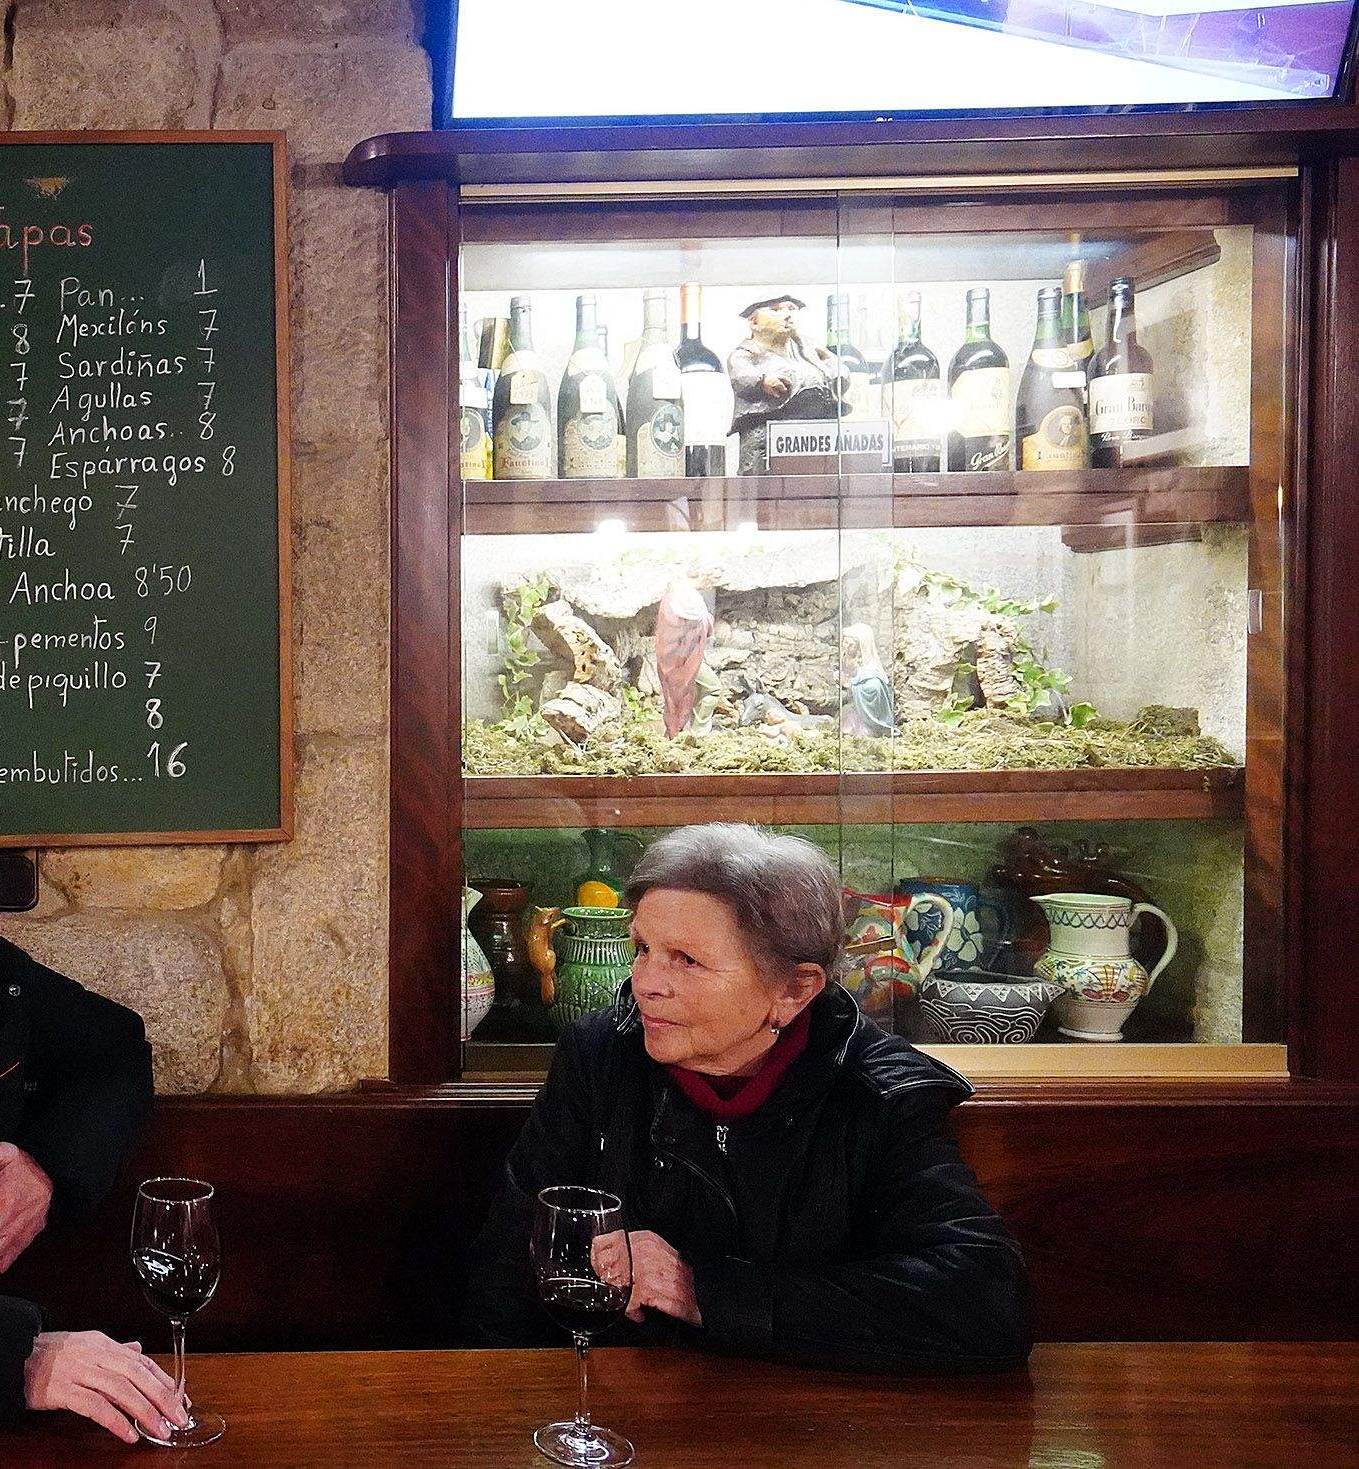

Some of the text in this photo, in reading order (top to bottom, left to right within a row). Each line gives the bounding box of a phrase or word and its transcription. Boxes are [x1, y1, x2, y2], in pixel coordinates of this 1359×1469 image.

[194, 258, 217, 295] 1
[14, 280, 35, 314] 7
[12, 324, 30, 354] 8
[199, 310, 218, 341] 7
[11, 363, 28, 390] 7
[59, 346, 215, 380] Sardiñas 7
[7, 398, 28, 430] 7
[49, 382, 216, 422] Agullas 7
[198, 411, 216, 440] 8
[776, 429, 883, 453] GRANDES AÑADAS
[9, 438, 26, 467] 7
[50, 445, 235, 488] Espárragos 8
[115, 485, 139, 520] 7
[115, 524, 135, 555] 7
[9, 568, 116, 605] Anchoa
[143, 616, 157, 645] 9
[28, 661, 127, 709] piquillo
[144, 661, 162, 689] 7
[145, 699, 164, 729] 8
[146, 741, 189, 778] 16
